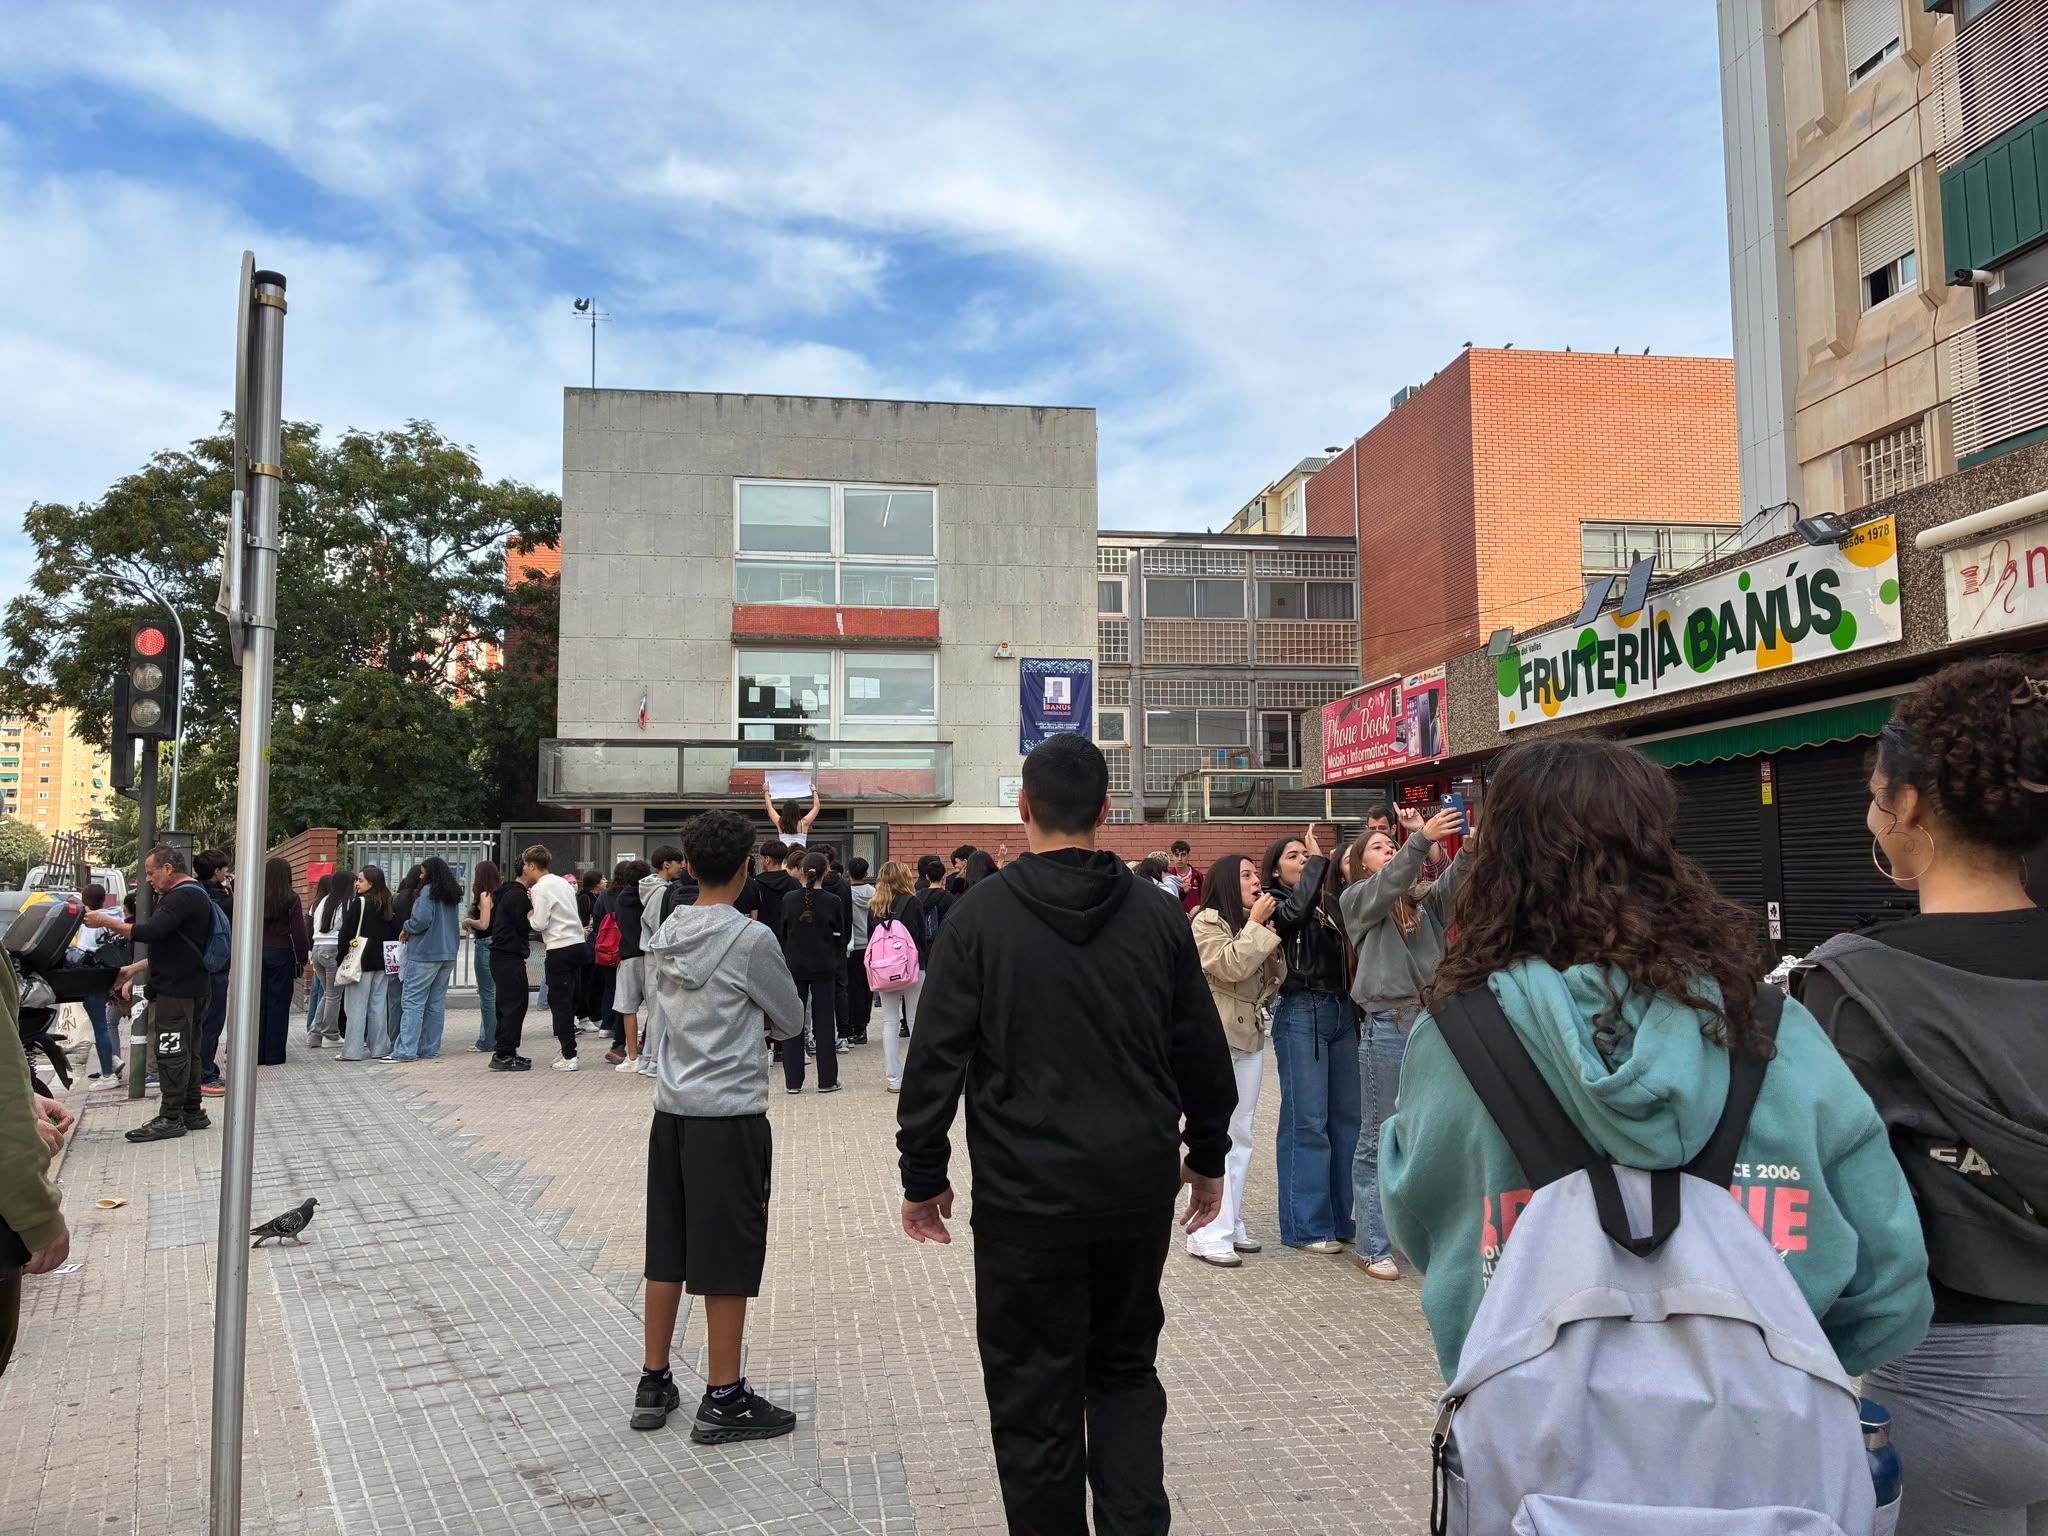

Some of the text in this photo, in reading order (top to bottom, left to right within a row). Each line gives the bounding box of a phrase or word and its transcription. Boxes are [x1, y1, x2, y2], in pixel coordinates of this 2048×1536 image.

[1868, 524, 1890, 541] 1978
[1518, 561, 1842, 711] FRUITERIA BANÚS
[1327, 699, 1390, 751] Phone Book
[1756, 1164, 1801, 1180] 2006
